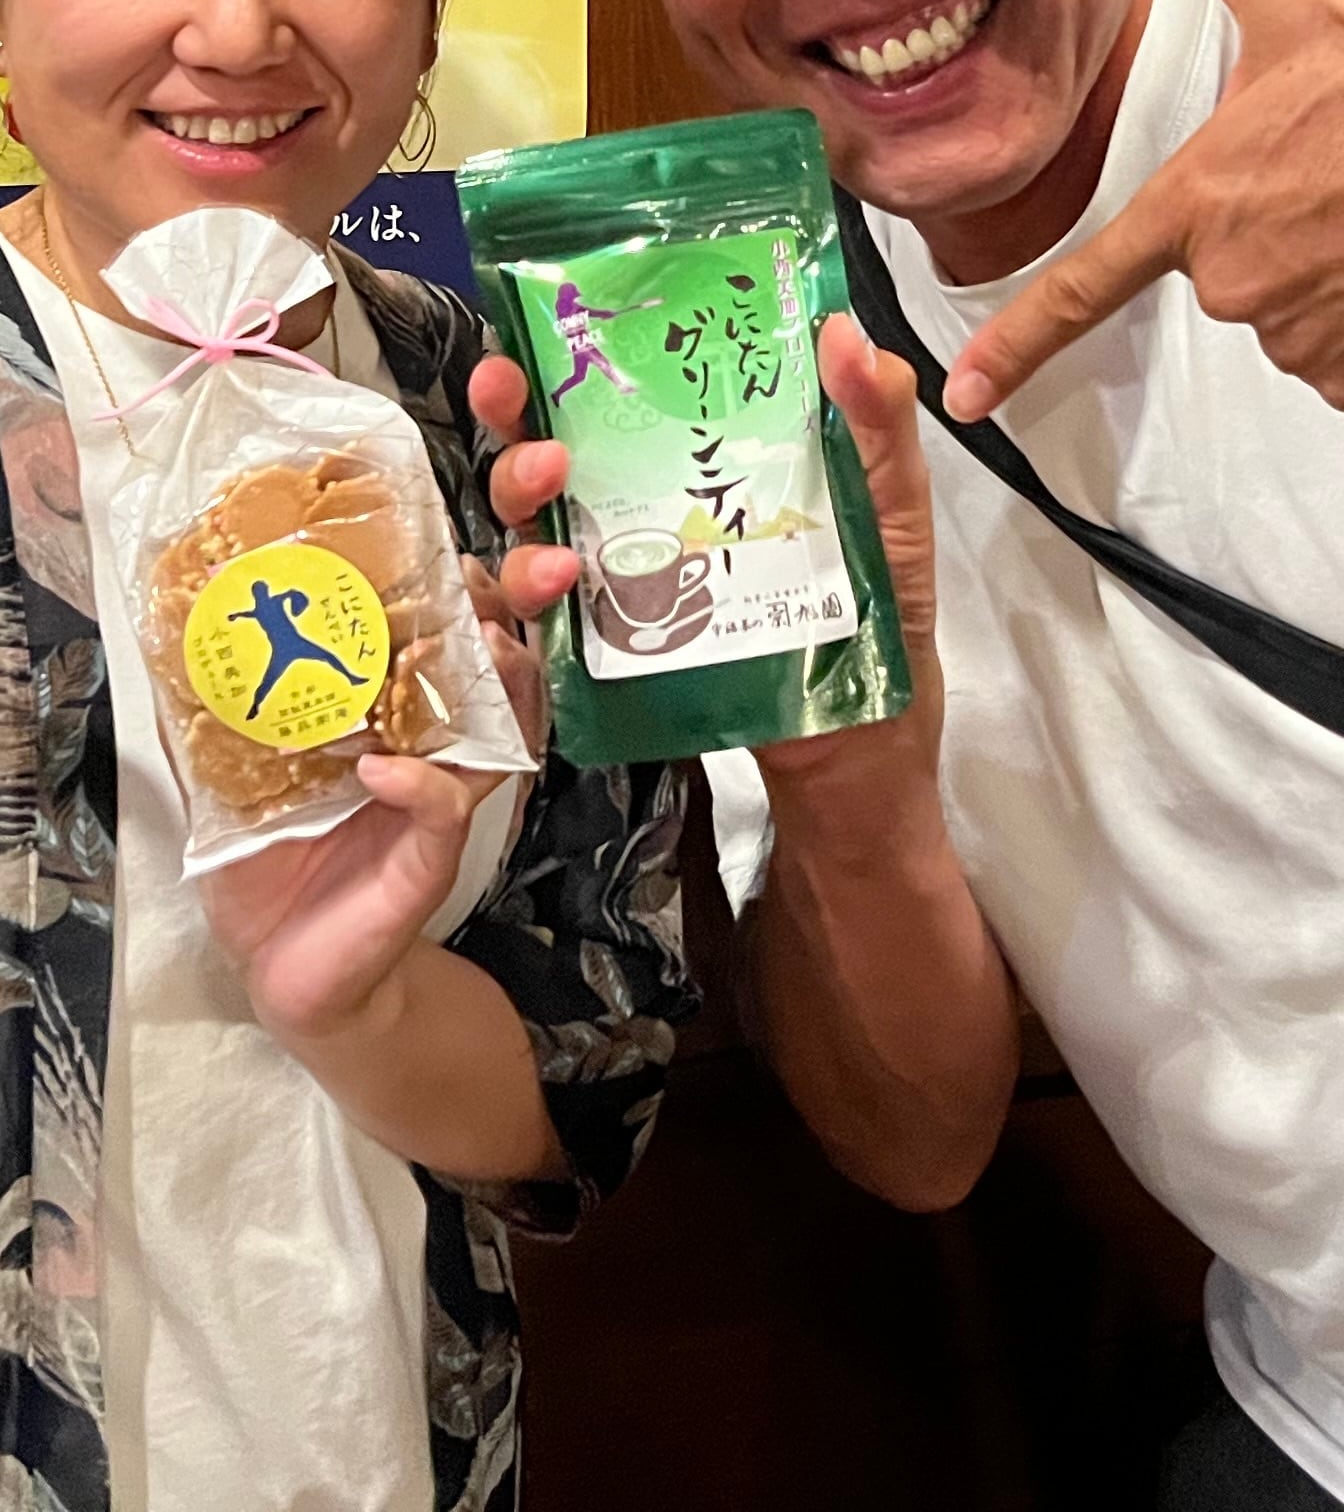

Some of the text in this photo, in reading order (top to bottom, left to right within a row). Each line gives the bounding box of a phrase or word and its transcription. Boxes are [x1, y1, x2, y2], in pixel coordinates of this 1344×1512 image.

[726, 275, 783, 401] こにたん
[664, 306, 747, 576] グリーンティー
[335, 573, 376, 662] こにたん
